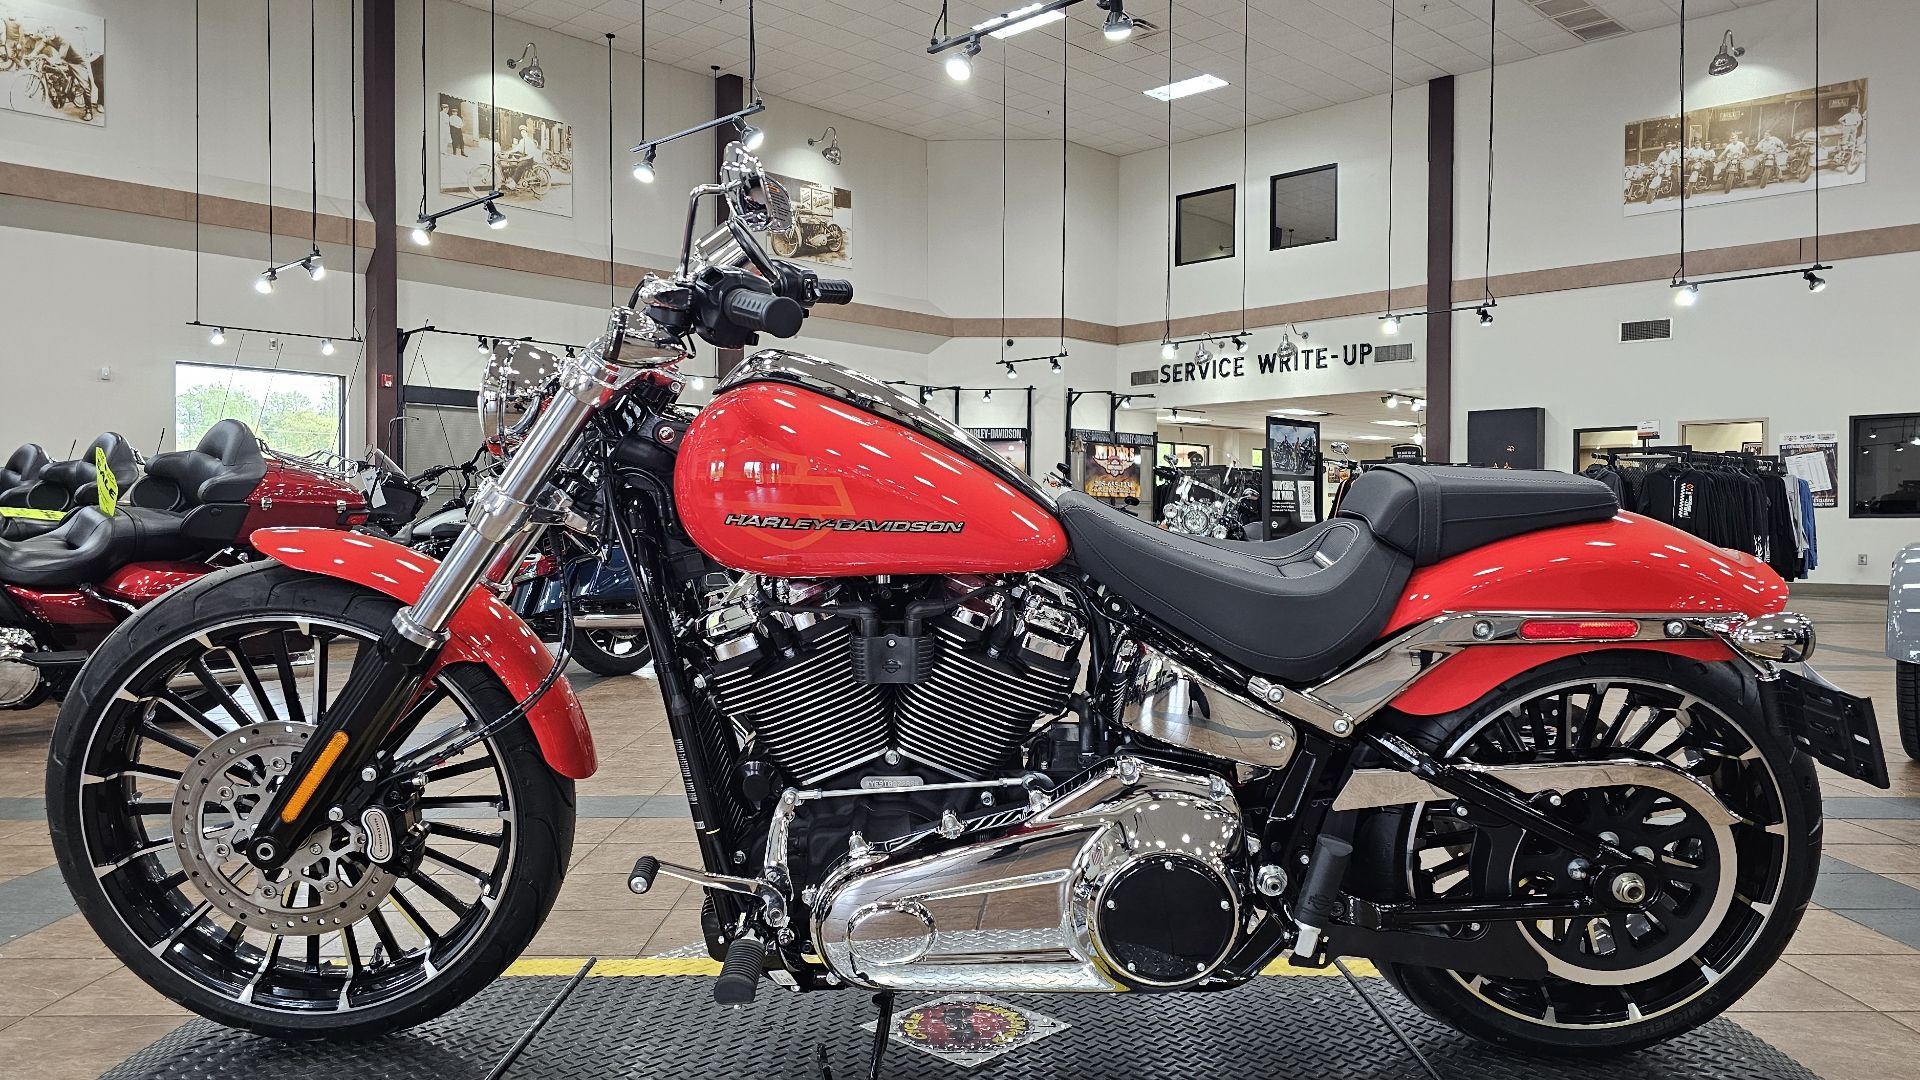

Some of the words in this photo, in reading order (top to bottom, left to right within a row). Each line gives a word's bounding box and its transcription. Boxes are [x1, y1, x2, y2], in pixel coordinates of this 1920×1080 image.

[1160, 357, 1245, 383] SERVICE
[1257, 343, 1373, 374] WRITE-UP
[725, 513, 965, 533] HARLEY-DAVIDSON
